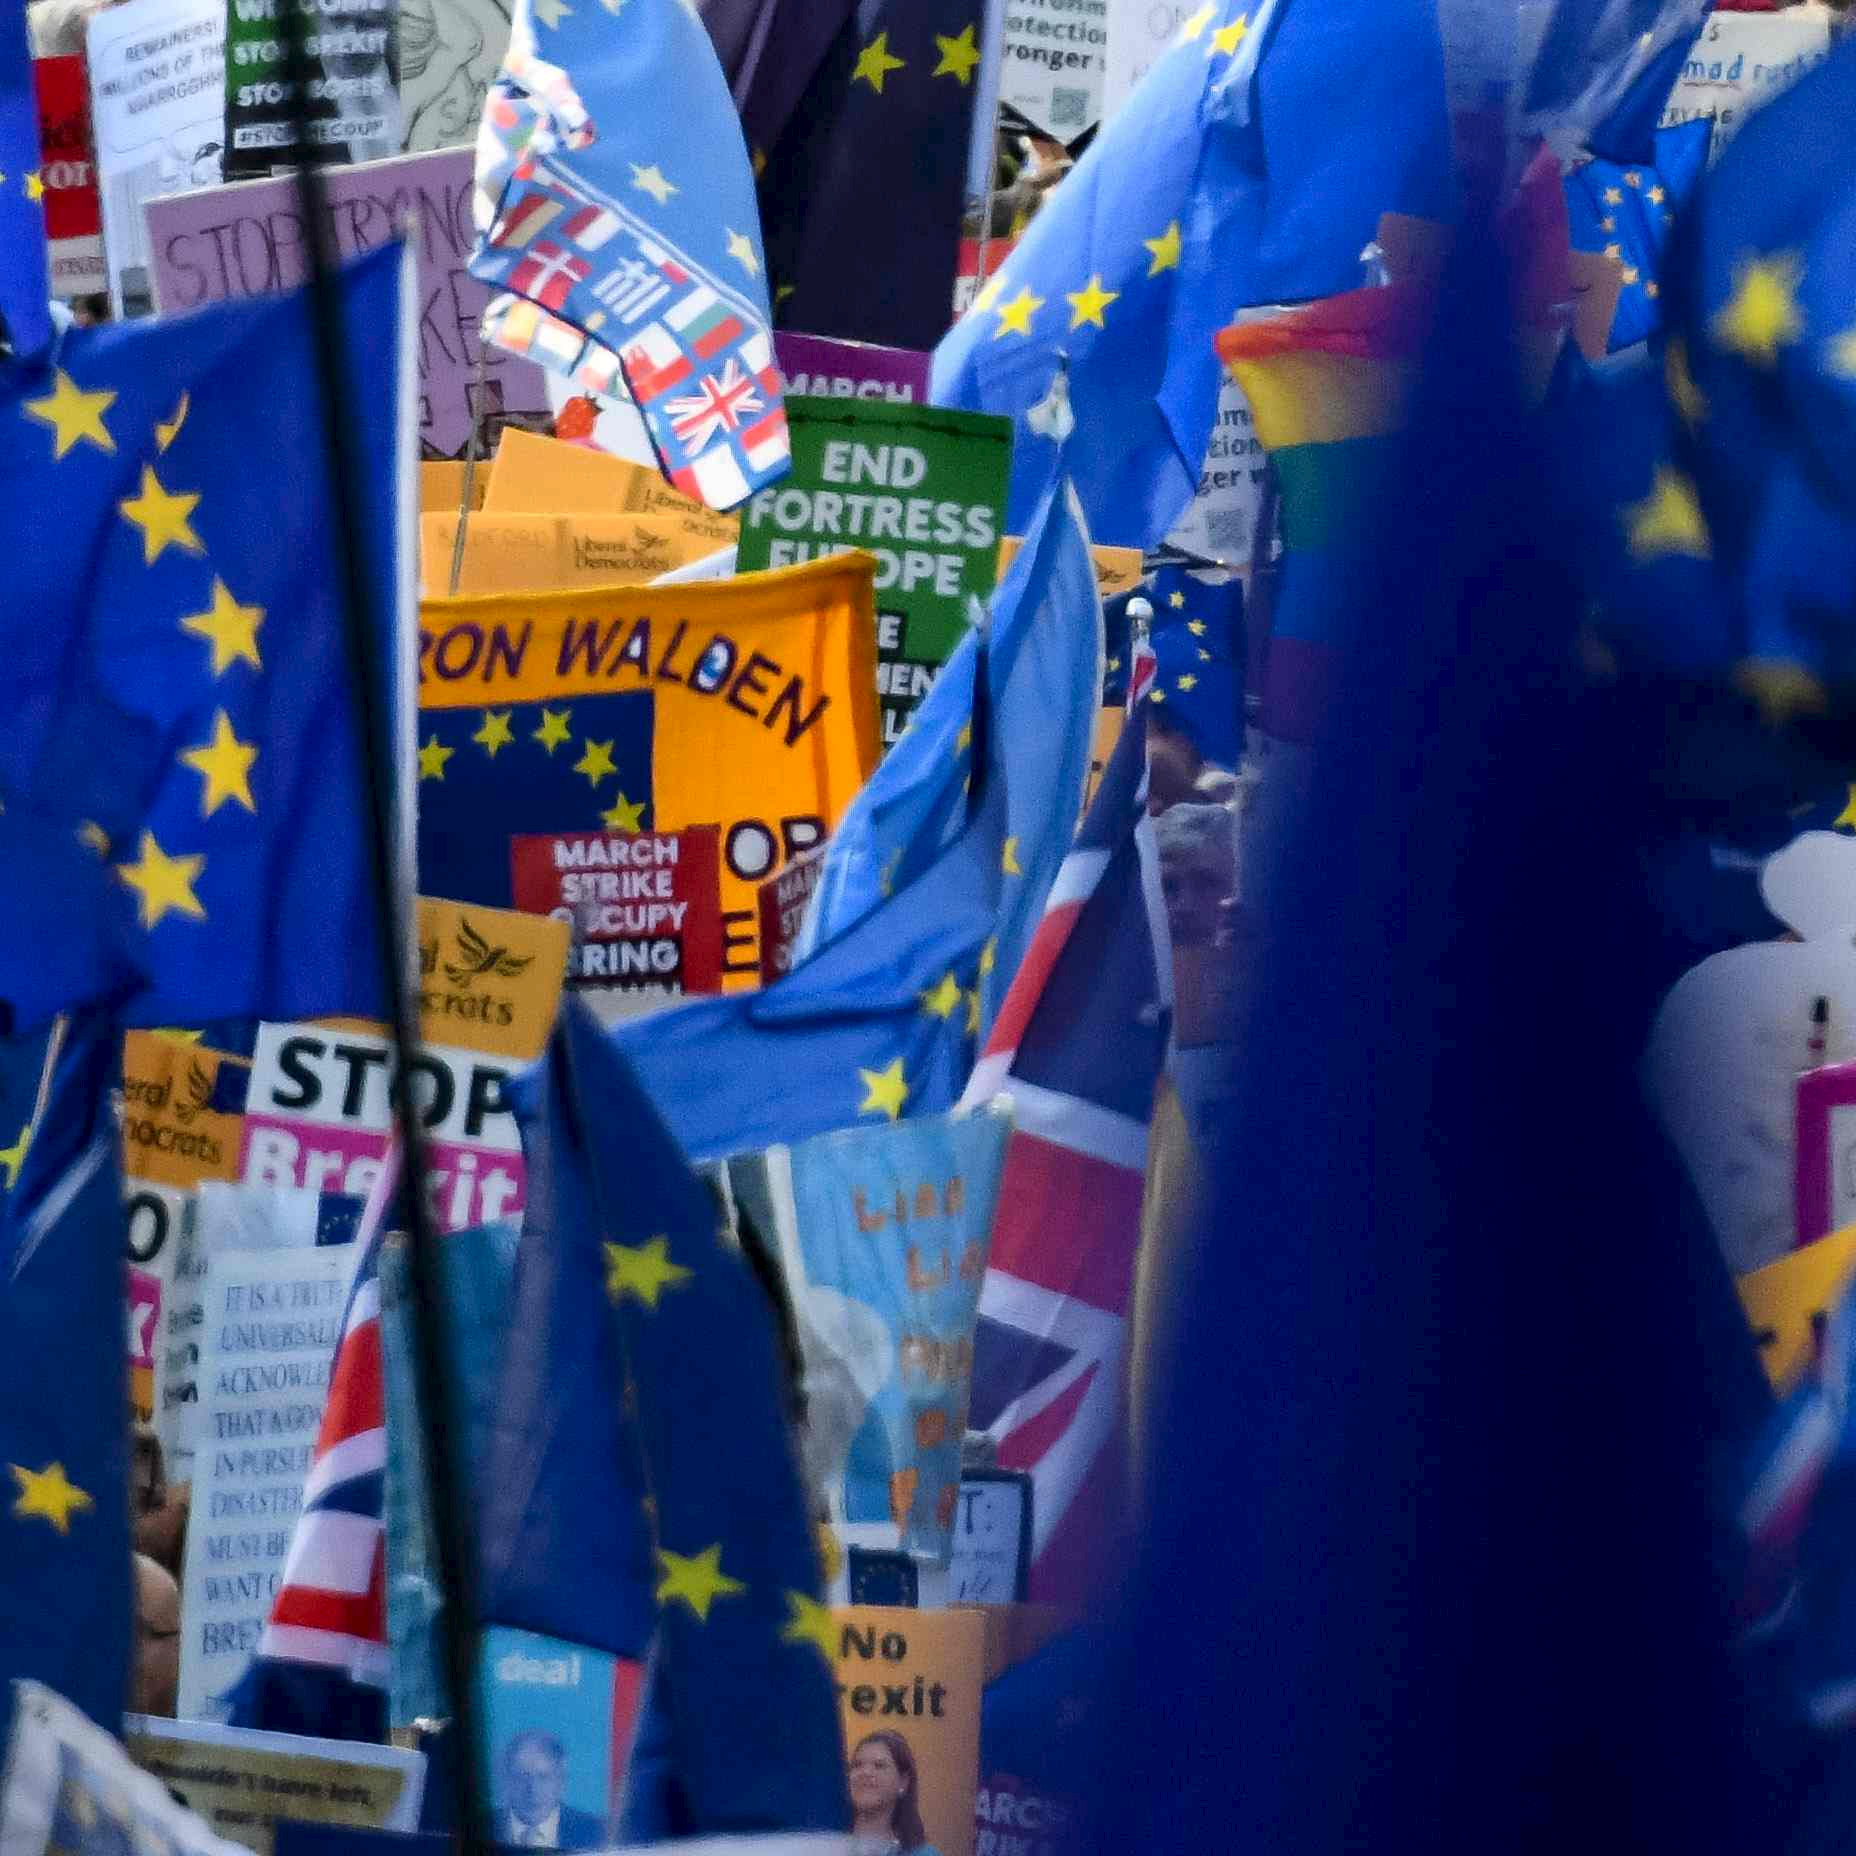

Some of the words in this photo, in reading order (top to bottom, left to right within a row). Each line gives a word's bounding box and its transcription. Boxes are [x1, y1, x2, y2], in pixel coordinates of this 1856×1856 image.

[235, 117, 387, 147] #STOHECOUP
[822, 440, 930, 491] END
[748, 488, 997, 550] FORTRESS
[769, 538, 964, 598] EUOPE
[555, 616, 828, 746] WALDEN
[552, 836, 680, 869] MARCH
[560, 870, 675, 902] STRIKE
[270, 1034, 526, 1138] STOP
[246, 1124, 523, 1231] Breit
[841, 1622, 908, 1662] No
[498, 1649, 581, 1689] deal
